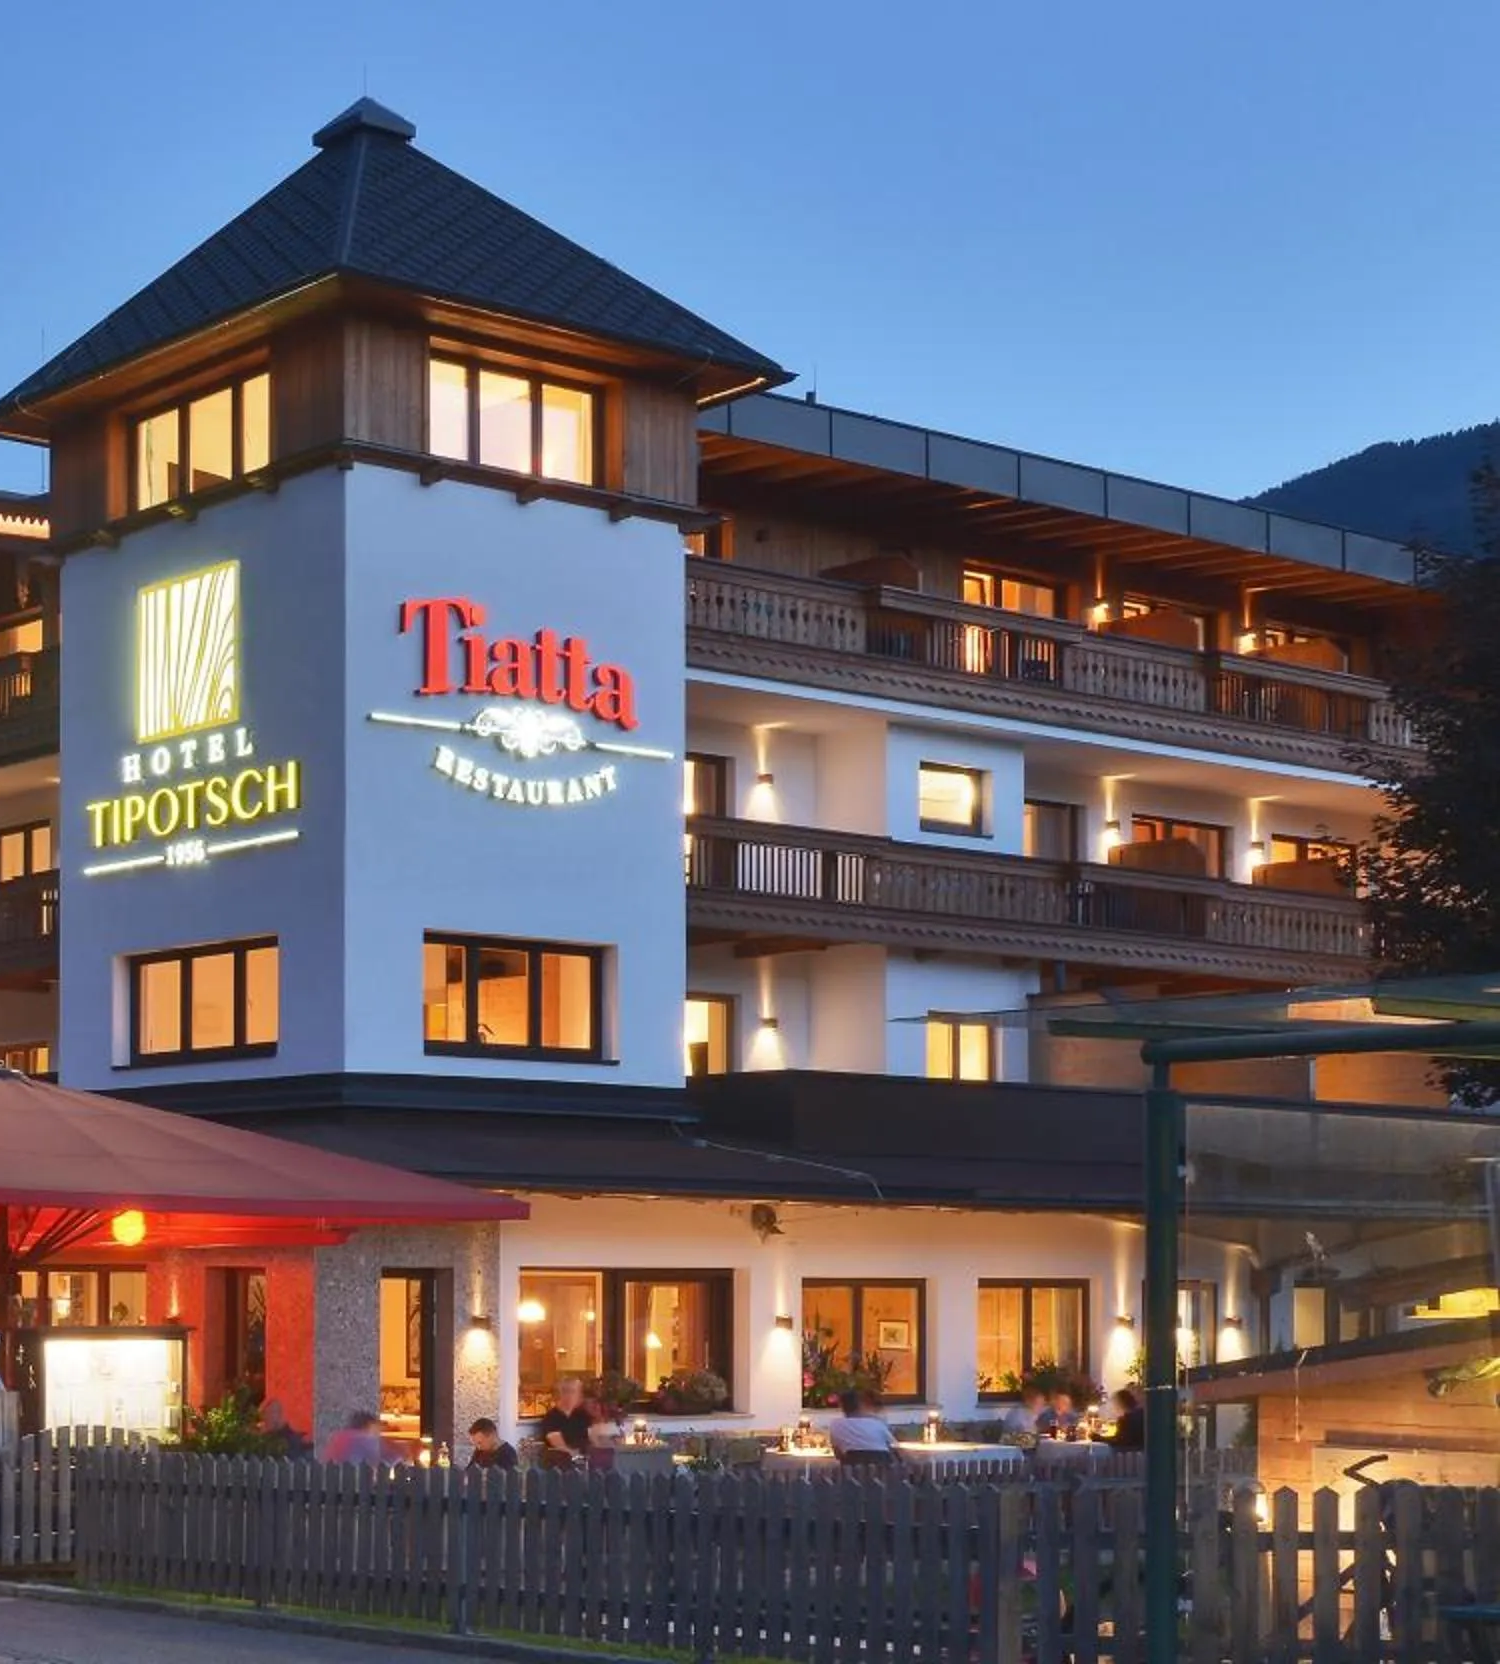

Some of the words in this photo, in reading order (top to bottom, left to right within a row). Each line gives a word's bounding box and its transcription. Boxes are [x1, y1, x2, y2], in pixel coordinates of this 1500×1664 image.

[400, 595, 639, 732] Tiatta
[121, 727, 253, 782] HOTEL
[434, 746, 617, 804] RESTAURANT
[86, 760, 299, 847] TIPOTSCH
